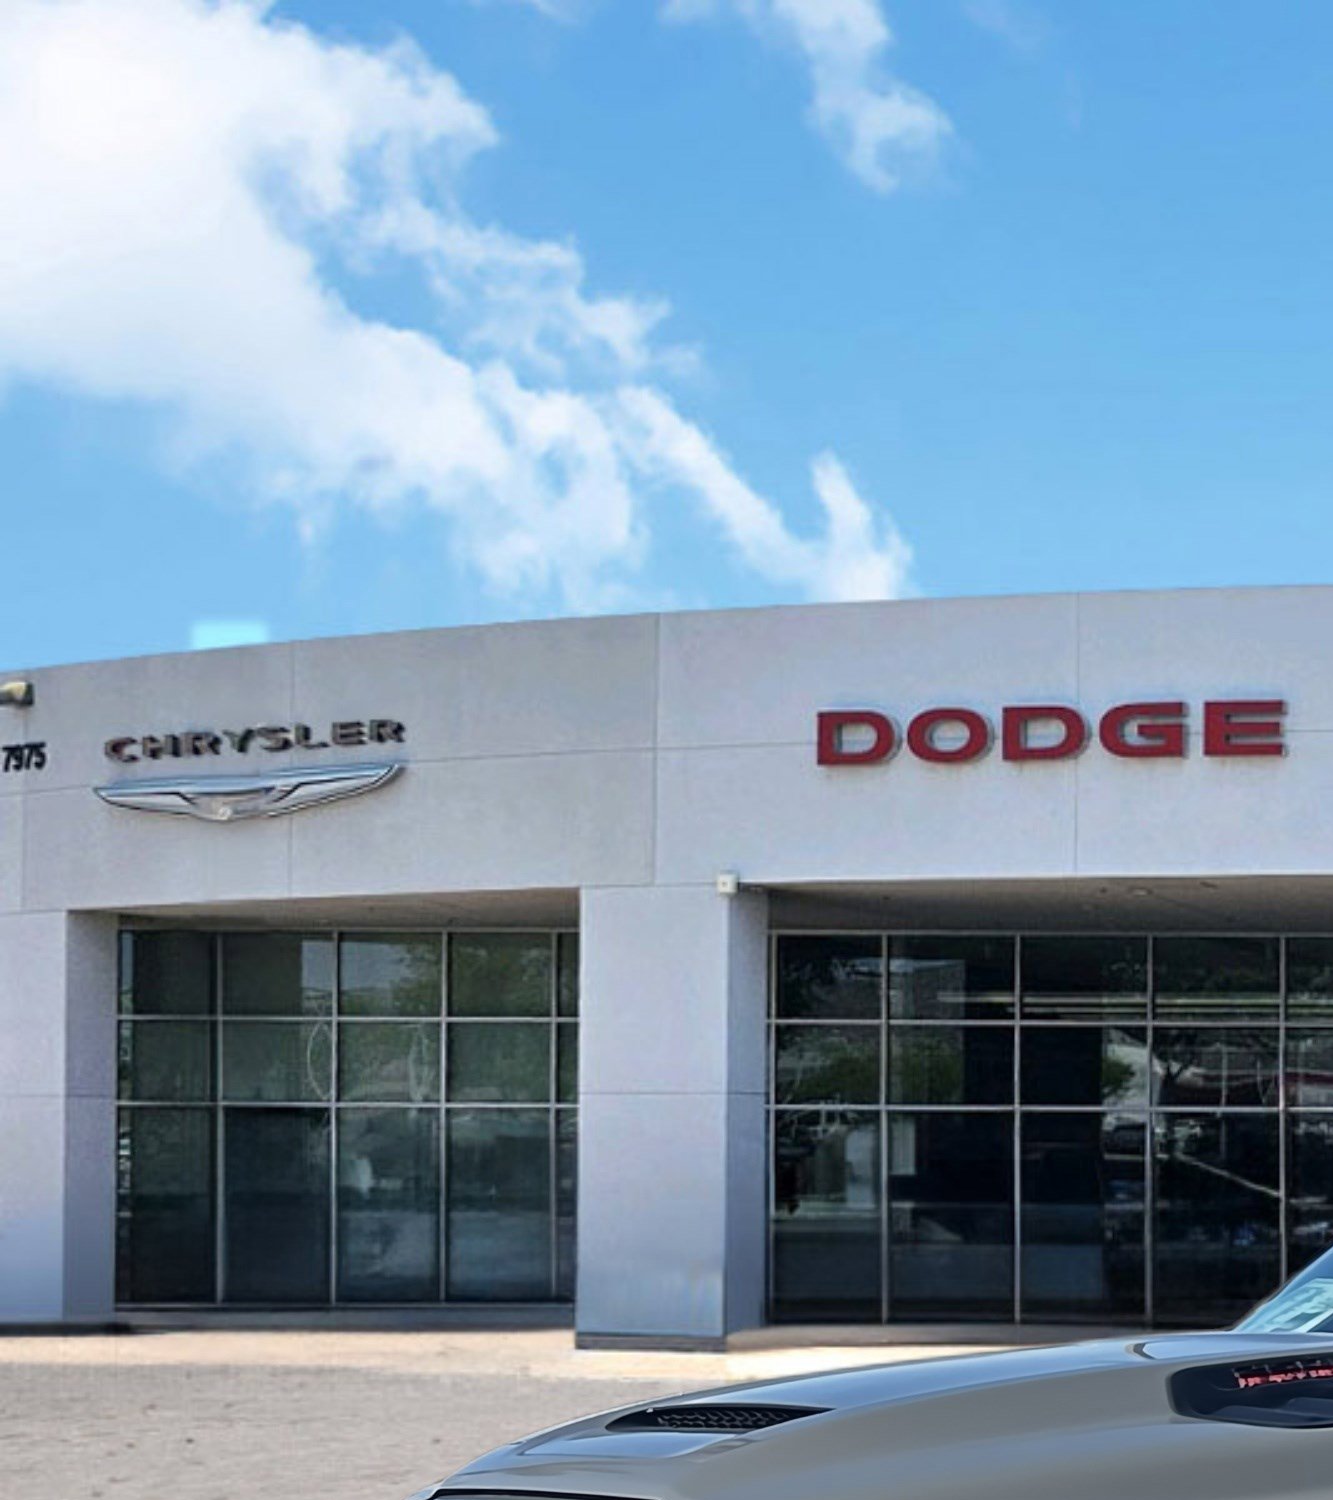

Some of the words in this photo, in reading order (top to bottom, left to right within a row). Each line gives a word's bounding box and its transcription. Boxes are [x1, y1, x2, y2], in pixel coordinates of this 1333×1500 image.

[104, 719, 405, 763] CHRYSLER
[816, 700, 1290, 766] DODGE
[2, 741, 47, 772] 7975
